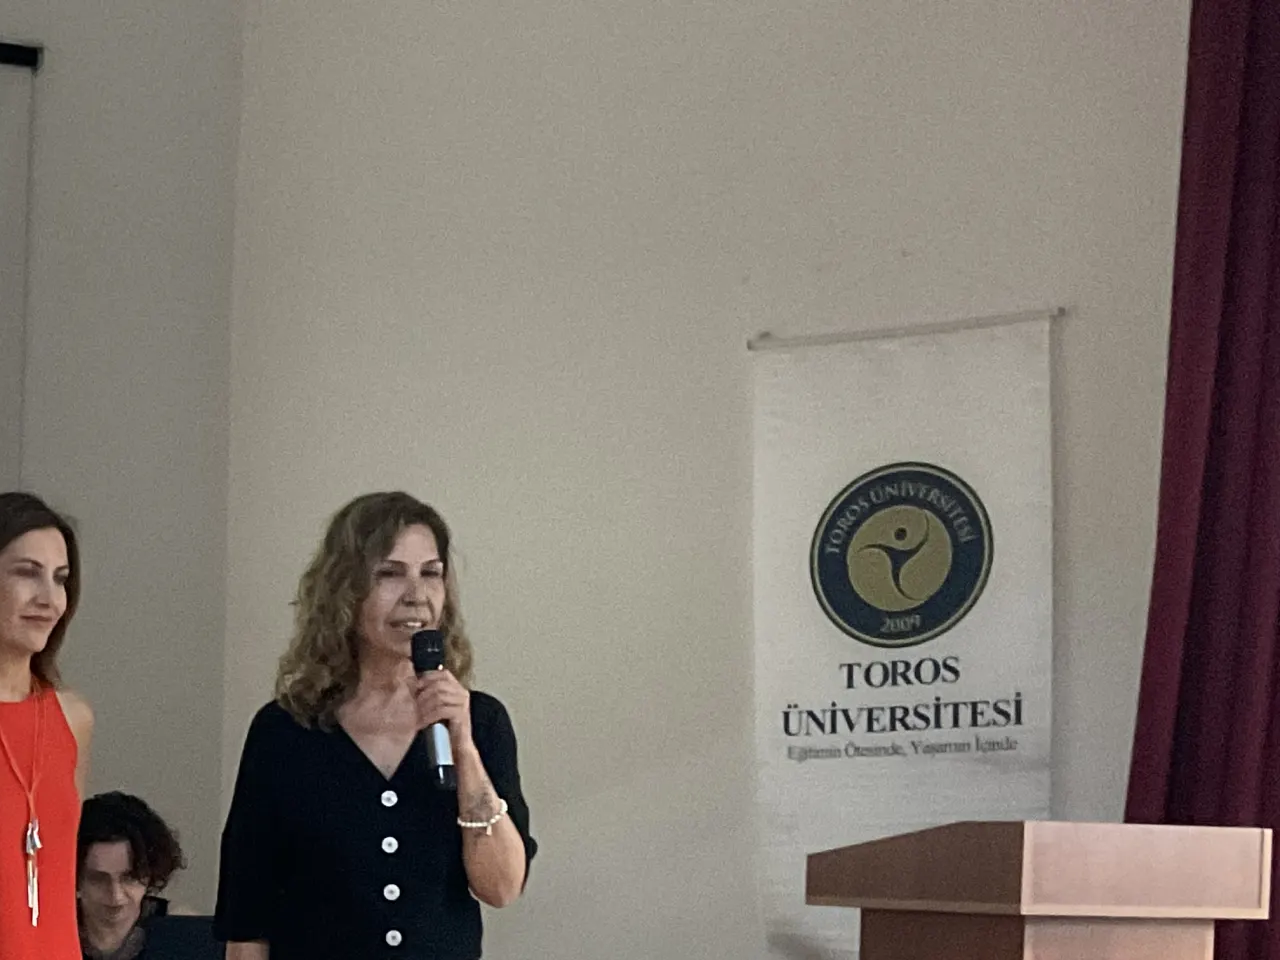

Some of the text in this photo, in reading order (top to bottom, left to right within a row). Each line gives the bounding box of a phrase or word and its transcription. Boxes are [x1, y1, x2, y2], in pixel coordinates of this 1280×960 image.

[824, 495, 871, 554] TOROS
[838, 656, 961, 690] TOROS
[782, 691, 1024, 737] ÜNİVERSİTESİ
